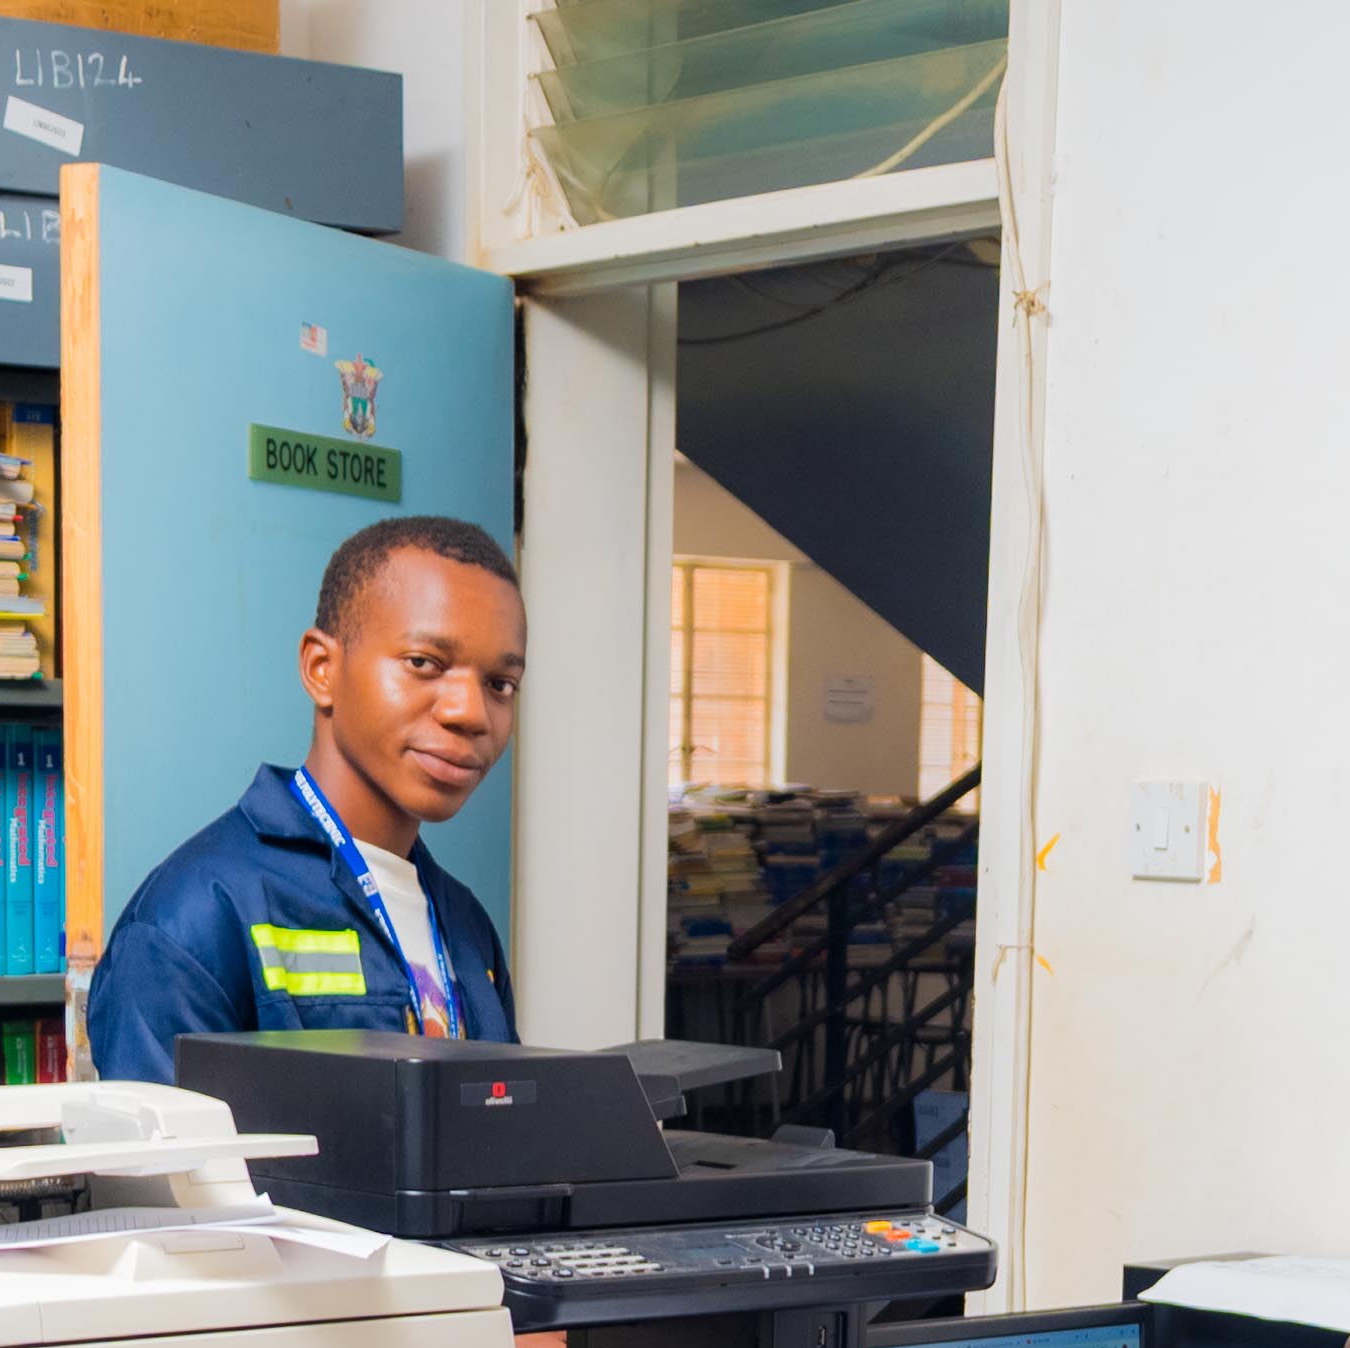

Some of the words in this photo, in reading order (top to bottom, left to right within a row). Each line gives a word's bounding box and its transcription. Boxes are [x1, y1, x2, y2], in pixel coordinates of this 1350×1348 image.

[15, 48, 143, 88] LIB124
[266, 438, 318, 476] BOOK
[327, 449, 387, 488] STORE
[13, 771, 32, 867] Integrated
[41, 774, 59, 868] Integrated
